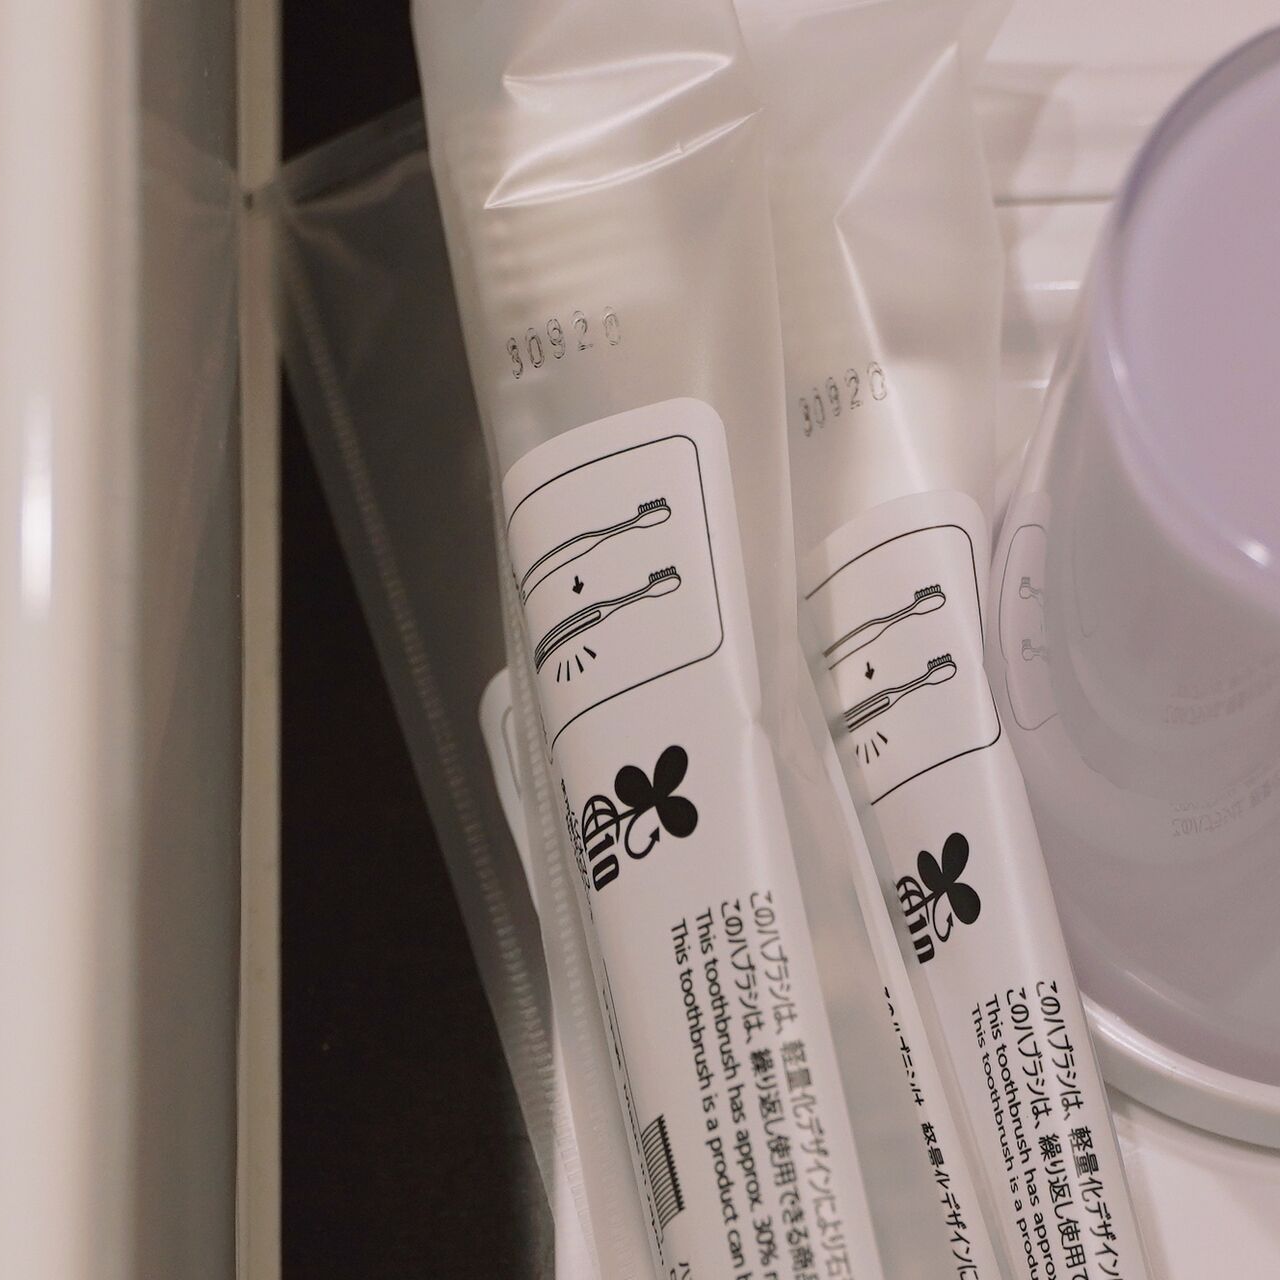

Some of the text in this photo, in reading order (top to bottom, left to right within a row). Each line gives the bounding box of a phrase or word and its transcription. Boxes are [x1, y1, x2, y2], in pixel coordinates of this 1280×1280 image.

[670, 917, 692, 967] This
[694, 906, 717, 956] This
[678, 967, 715, 1092] toothbrush
[703, 956, 742, 1082] toothbrush
[970, 1001, 987, 1050] This
[700, 1092, 719, 1114] is
[705, 1117, 720, 1133] a
[726, 1082, 747, 1125] has
[981, 1051, 1016, 1173] toothbrush
[984, 992, 1005, 1042] This
[995, 1042, 1033, 1165] toothbrush
[1022, 1166, 1041, 1208] has
[704, 1135, 740, 1226] product
[732, 1129, 764, 1213] approx.
[1008, 1174, 1020, 1195] is
[1013, 1198, 1024, 1213] a
[726, 1228, 746, 1270] can
[751, 1215, 779, 1268] 30%
